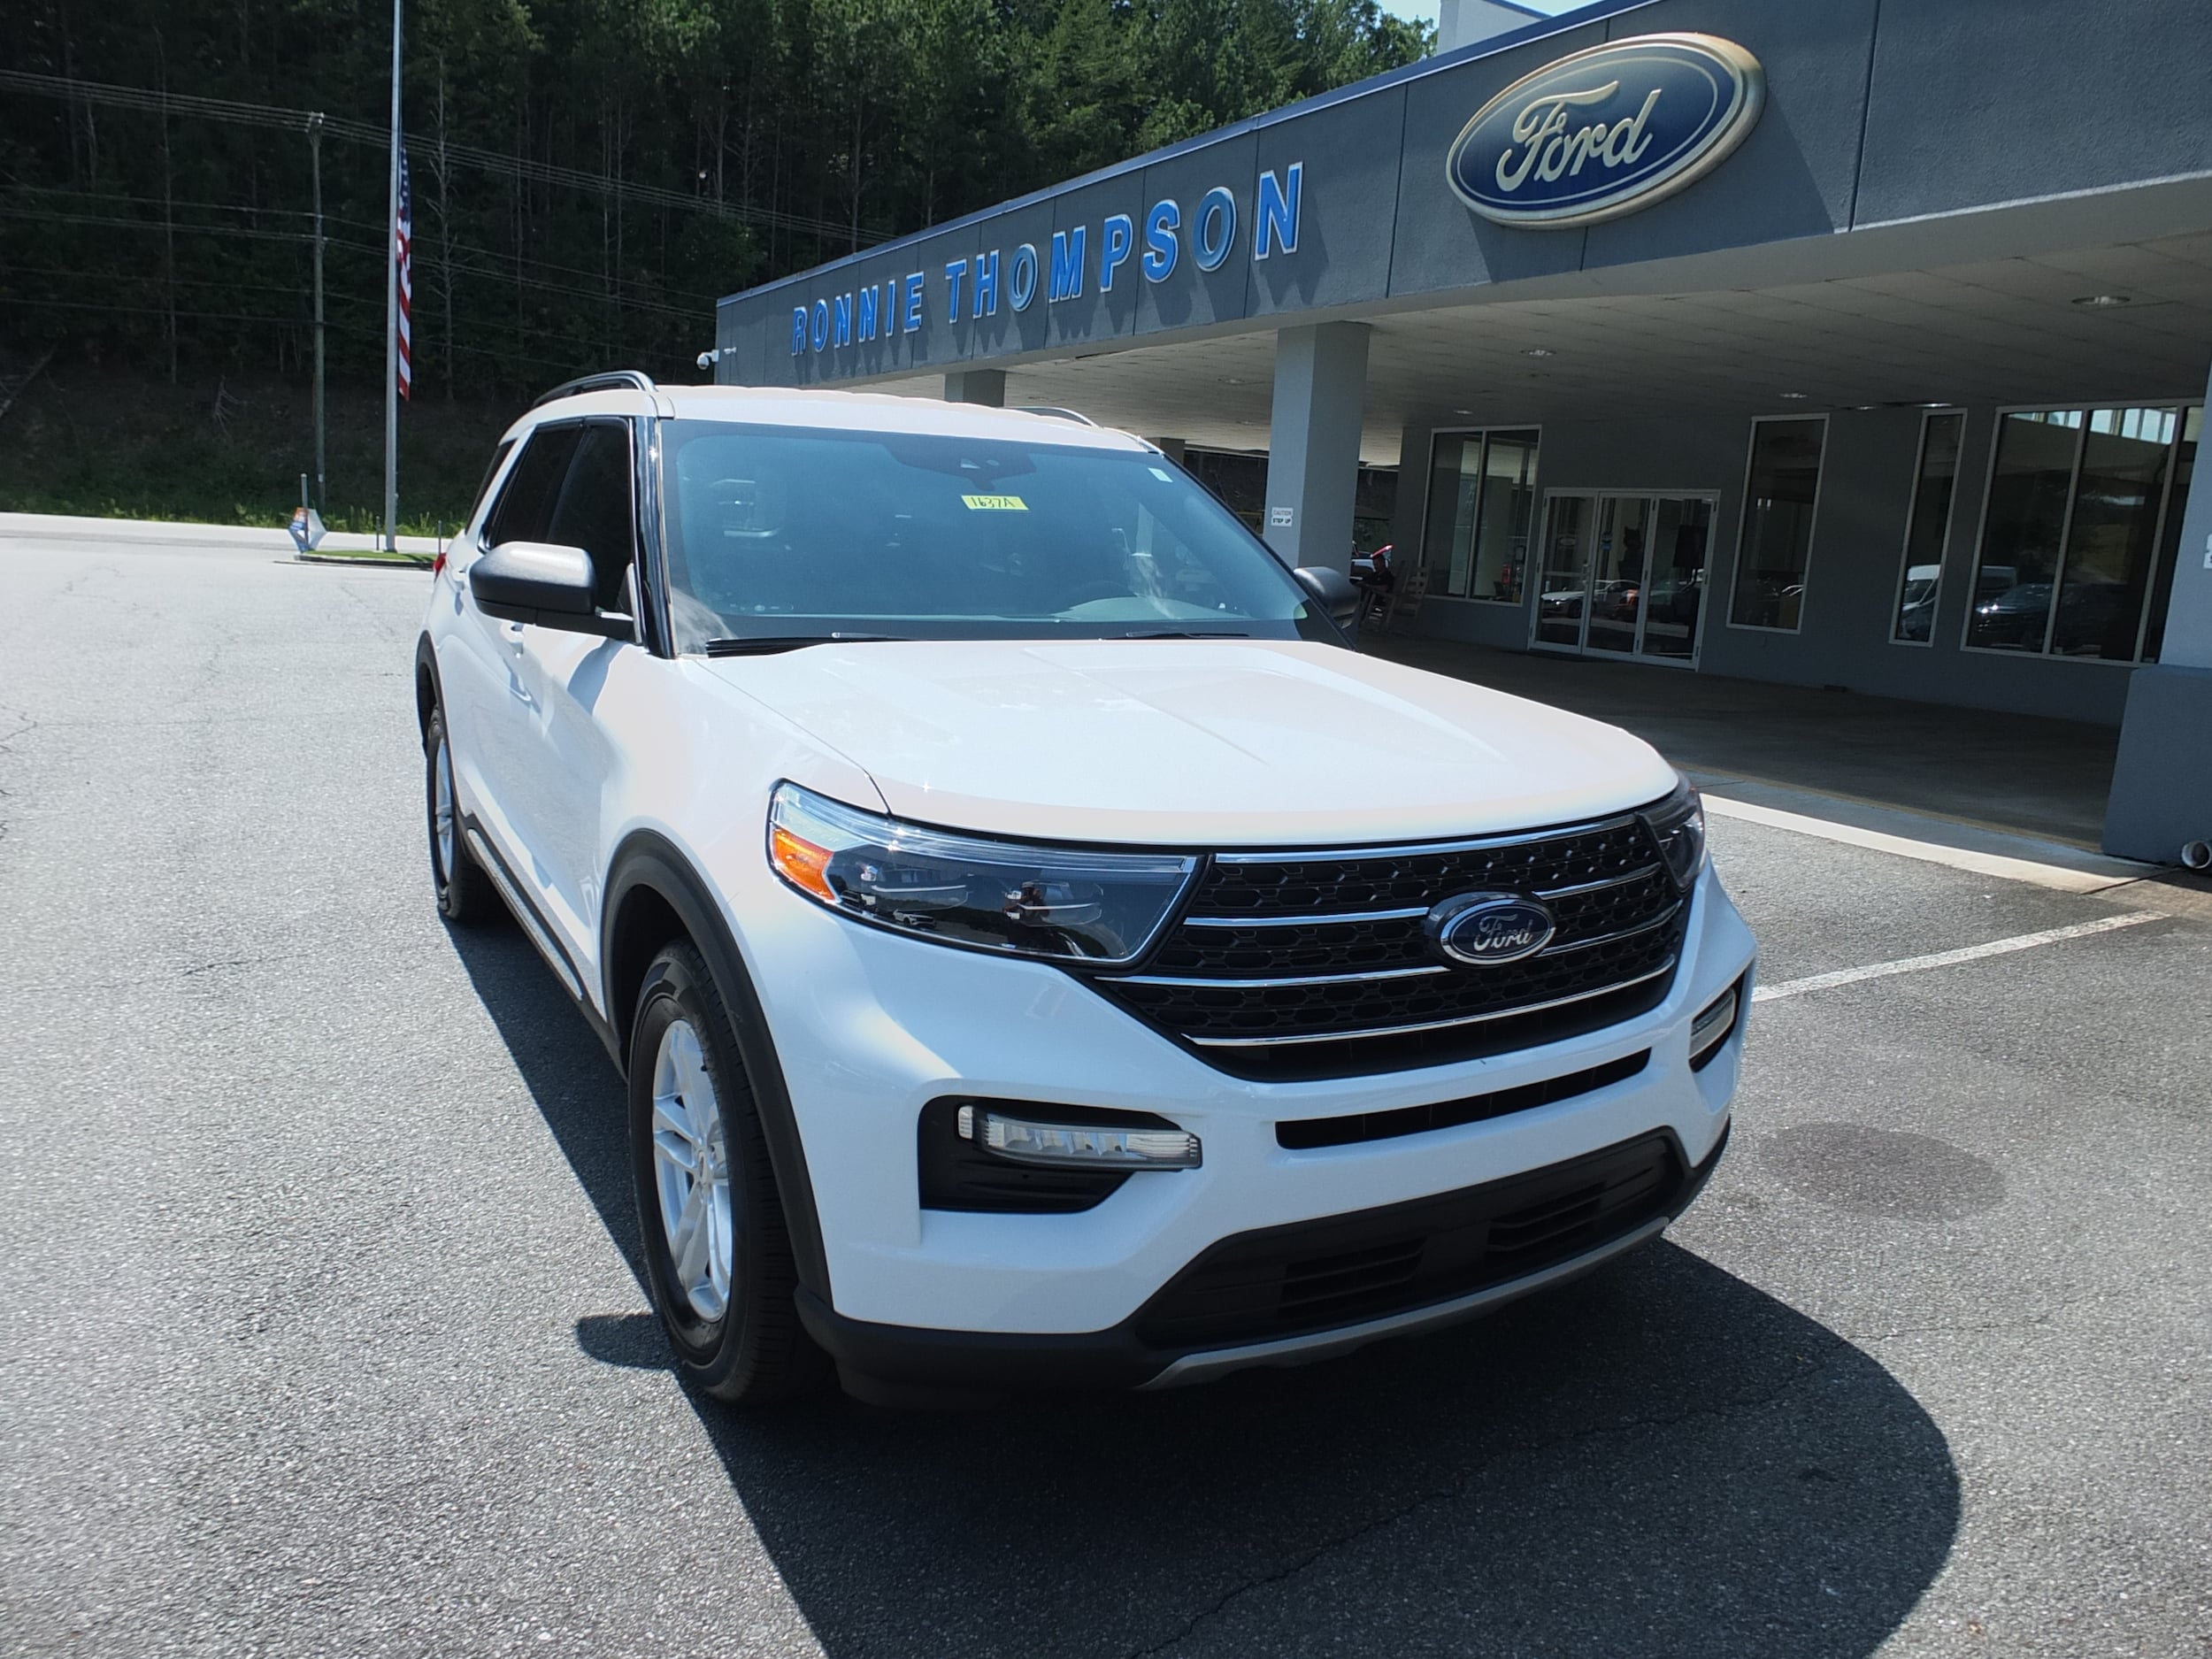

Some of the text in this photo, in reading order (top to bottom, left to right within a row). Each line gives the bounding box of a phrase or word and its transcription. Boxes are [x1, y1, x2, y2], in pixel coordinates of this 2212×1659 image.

[1495, 81, 1662, 192] Ford
[792, 161, 1304, 357] RONNIE THOMPSON
[1474, 914, 1533, 951] Ford
